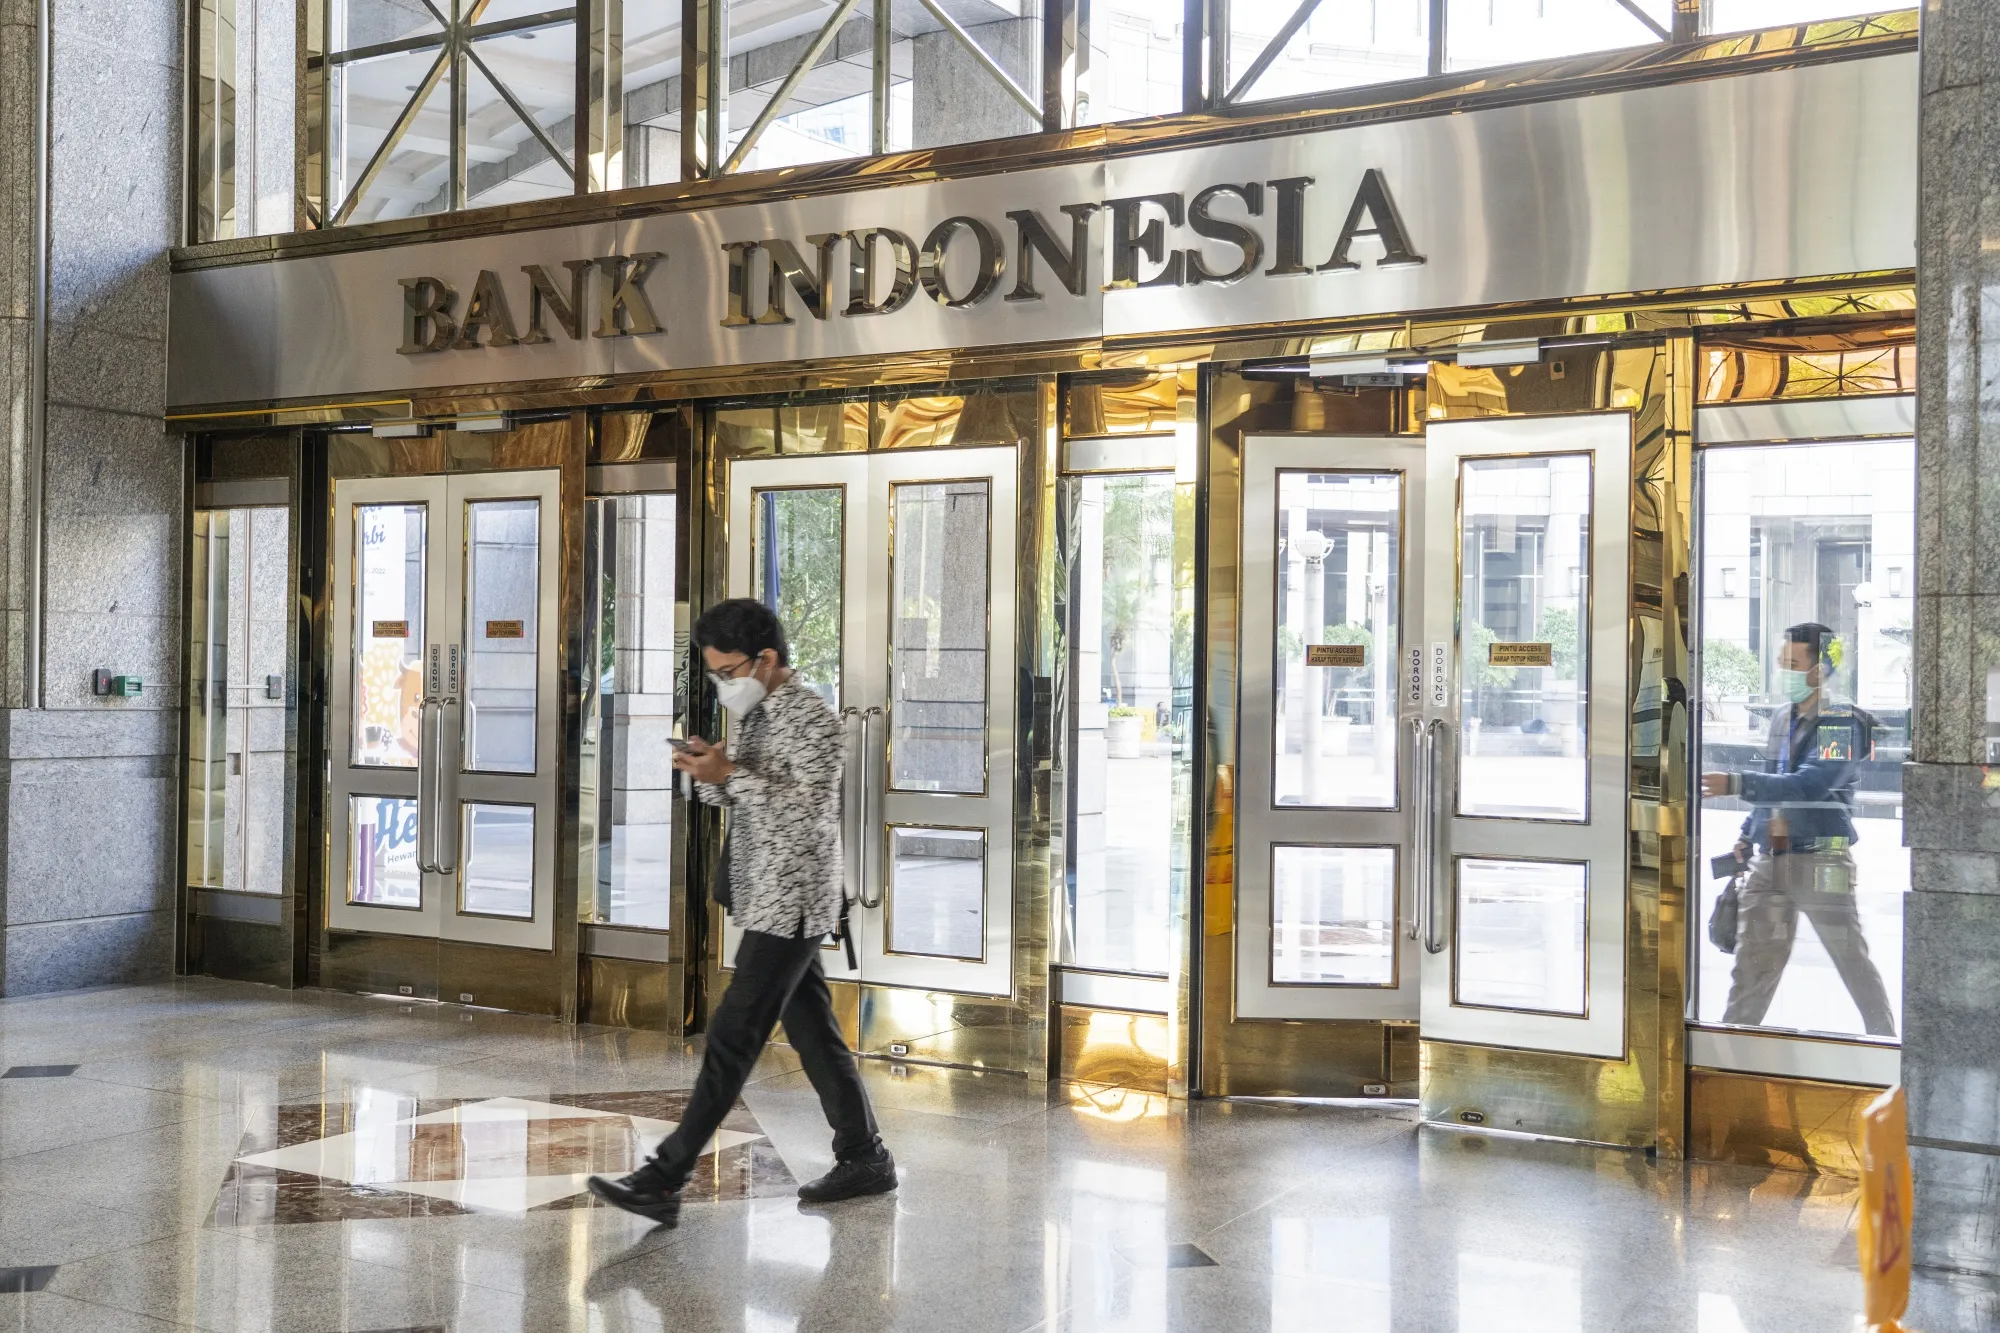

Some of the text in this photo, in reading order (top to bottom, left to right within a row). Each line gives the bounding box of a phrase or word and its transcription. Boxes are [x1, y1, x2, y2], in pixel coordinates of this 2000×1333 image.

[396, 167, 1427, 355] BANK INDONESIA
[1412, 649, 1420, 701] DORONG
[1435, 647, 1443, 701] DORONG
